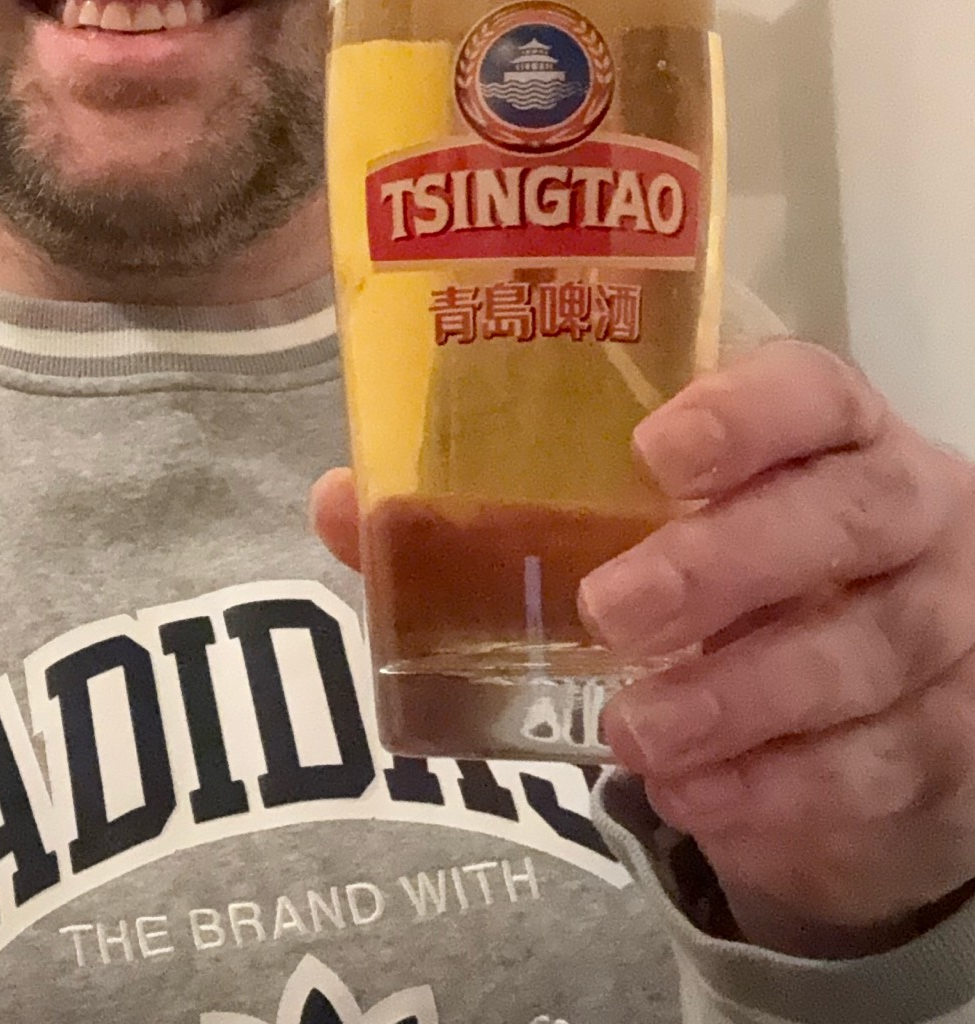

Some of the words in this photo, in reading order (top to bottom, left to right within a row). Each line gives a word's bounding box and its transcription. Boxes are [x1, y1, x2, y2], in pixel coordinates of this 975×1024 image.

[380, 165, 686, 243] TSINGTAO
[428, 281, 643, 345] 青島啤酒
[59, 915, 175, 968] THE
[188, 882, 386, 951] BRAND
[398, 857, 542, 917] WITH
